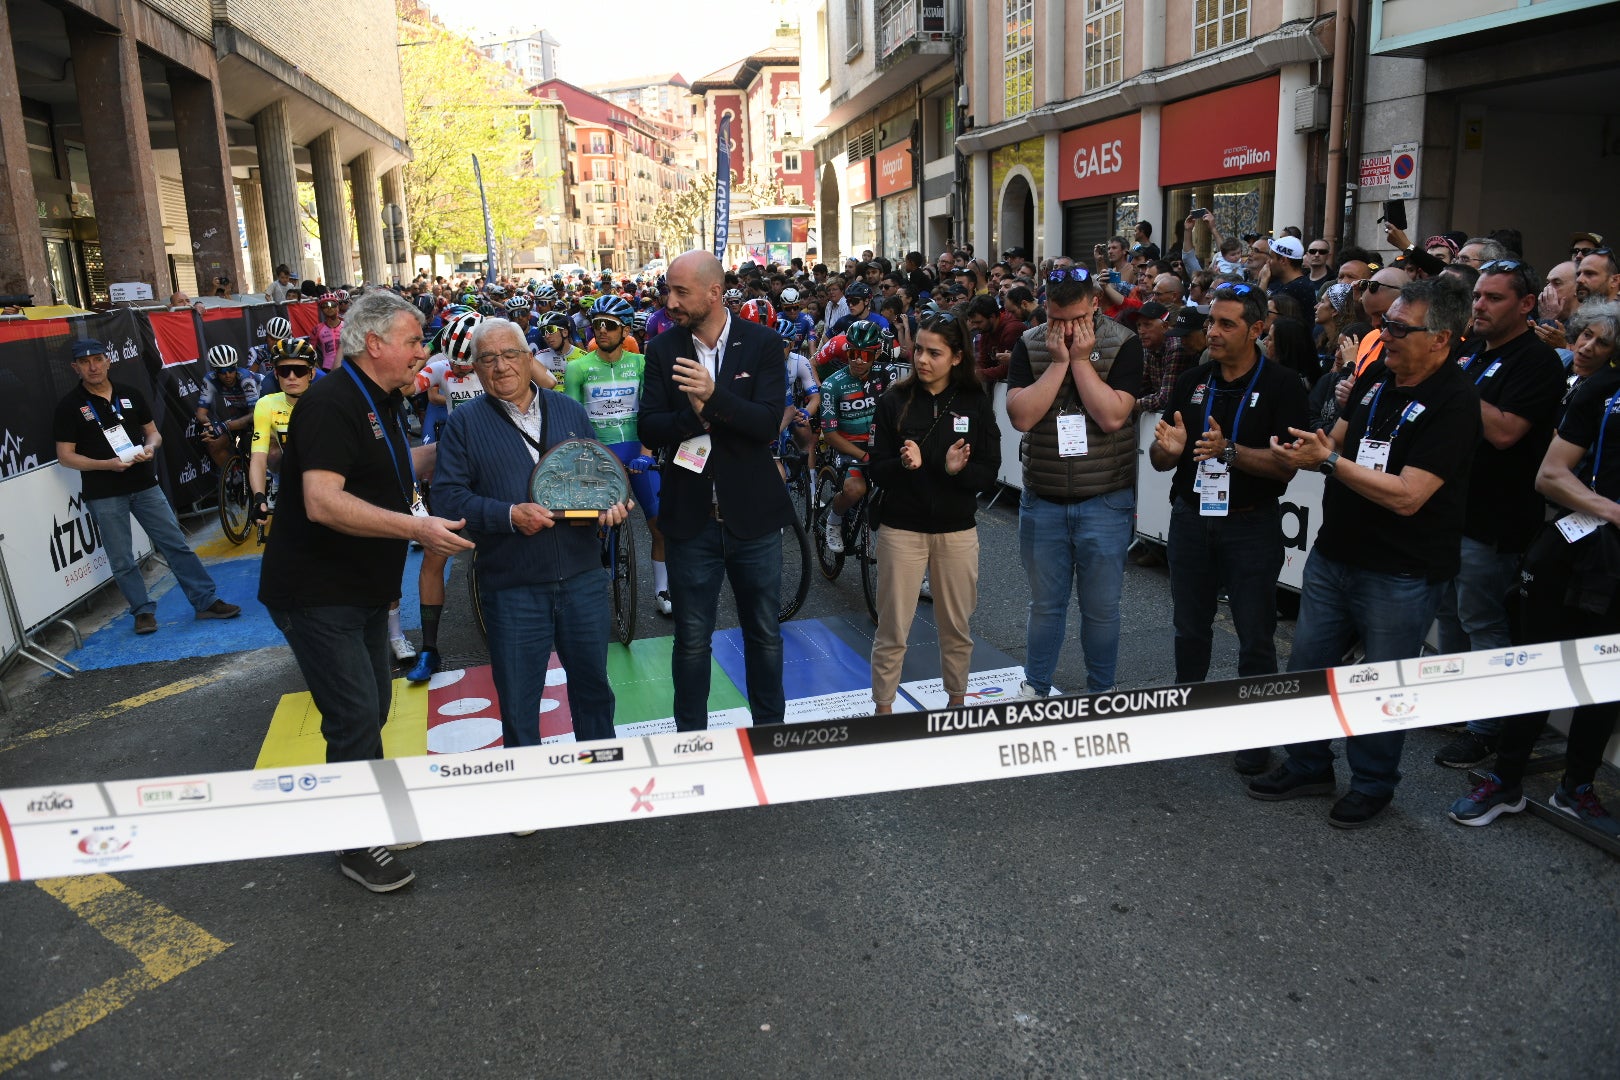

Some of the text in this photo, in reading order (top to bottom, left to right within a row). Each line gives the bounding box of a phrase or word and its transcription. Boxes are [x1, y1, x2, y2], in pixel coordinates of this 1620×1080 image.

[1073, 139, 1122, 179] GAES
[1223, 149, 1271, 170] amplifon
[1361, 156, 1390, 168] ALQUILA
[1276, 244, 1294, 256] KAS
[450, 390, 472, 402] CAJA
[595, 386, 633, 398] Jayco
[840, 396, 876, 411] BOR
[65, 554, 109, 587] BASQUE COU
[773, 679, 1301, 749] 8/4/2023 ITZULIA BASQUE COUNTRY 8/4/2023
[999, 739, 1057, 768] EIBAR
[1074, 731, 1131, 760] EIBAR
[439, 758, 515, 778] Sabadell
[549, 753, 575, 766] UCI
